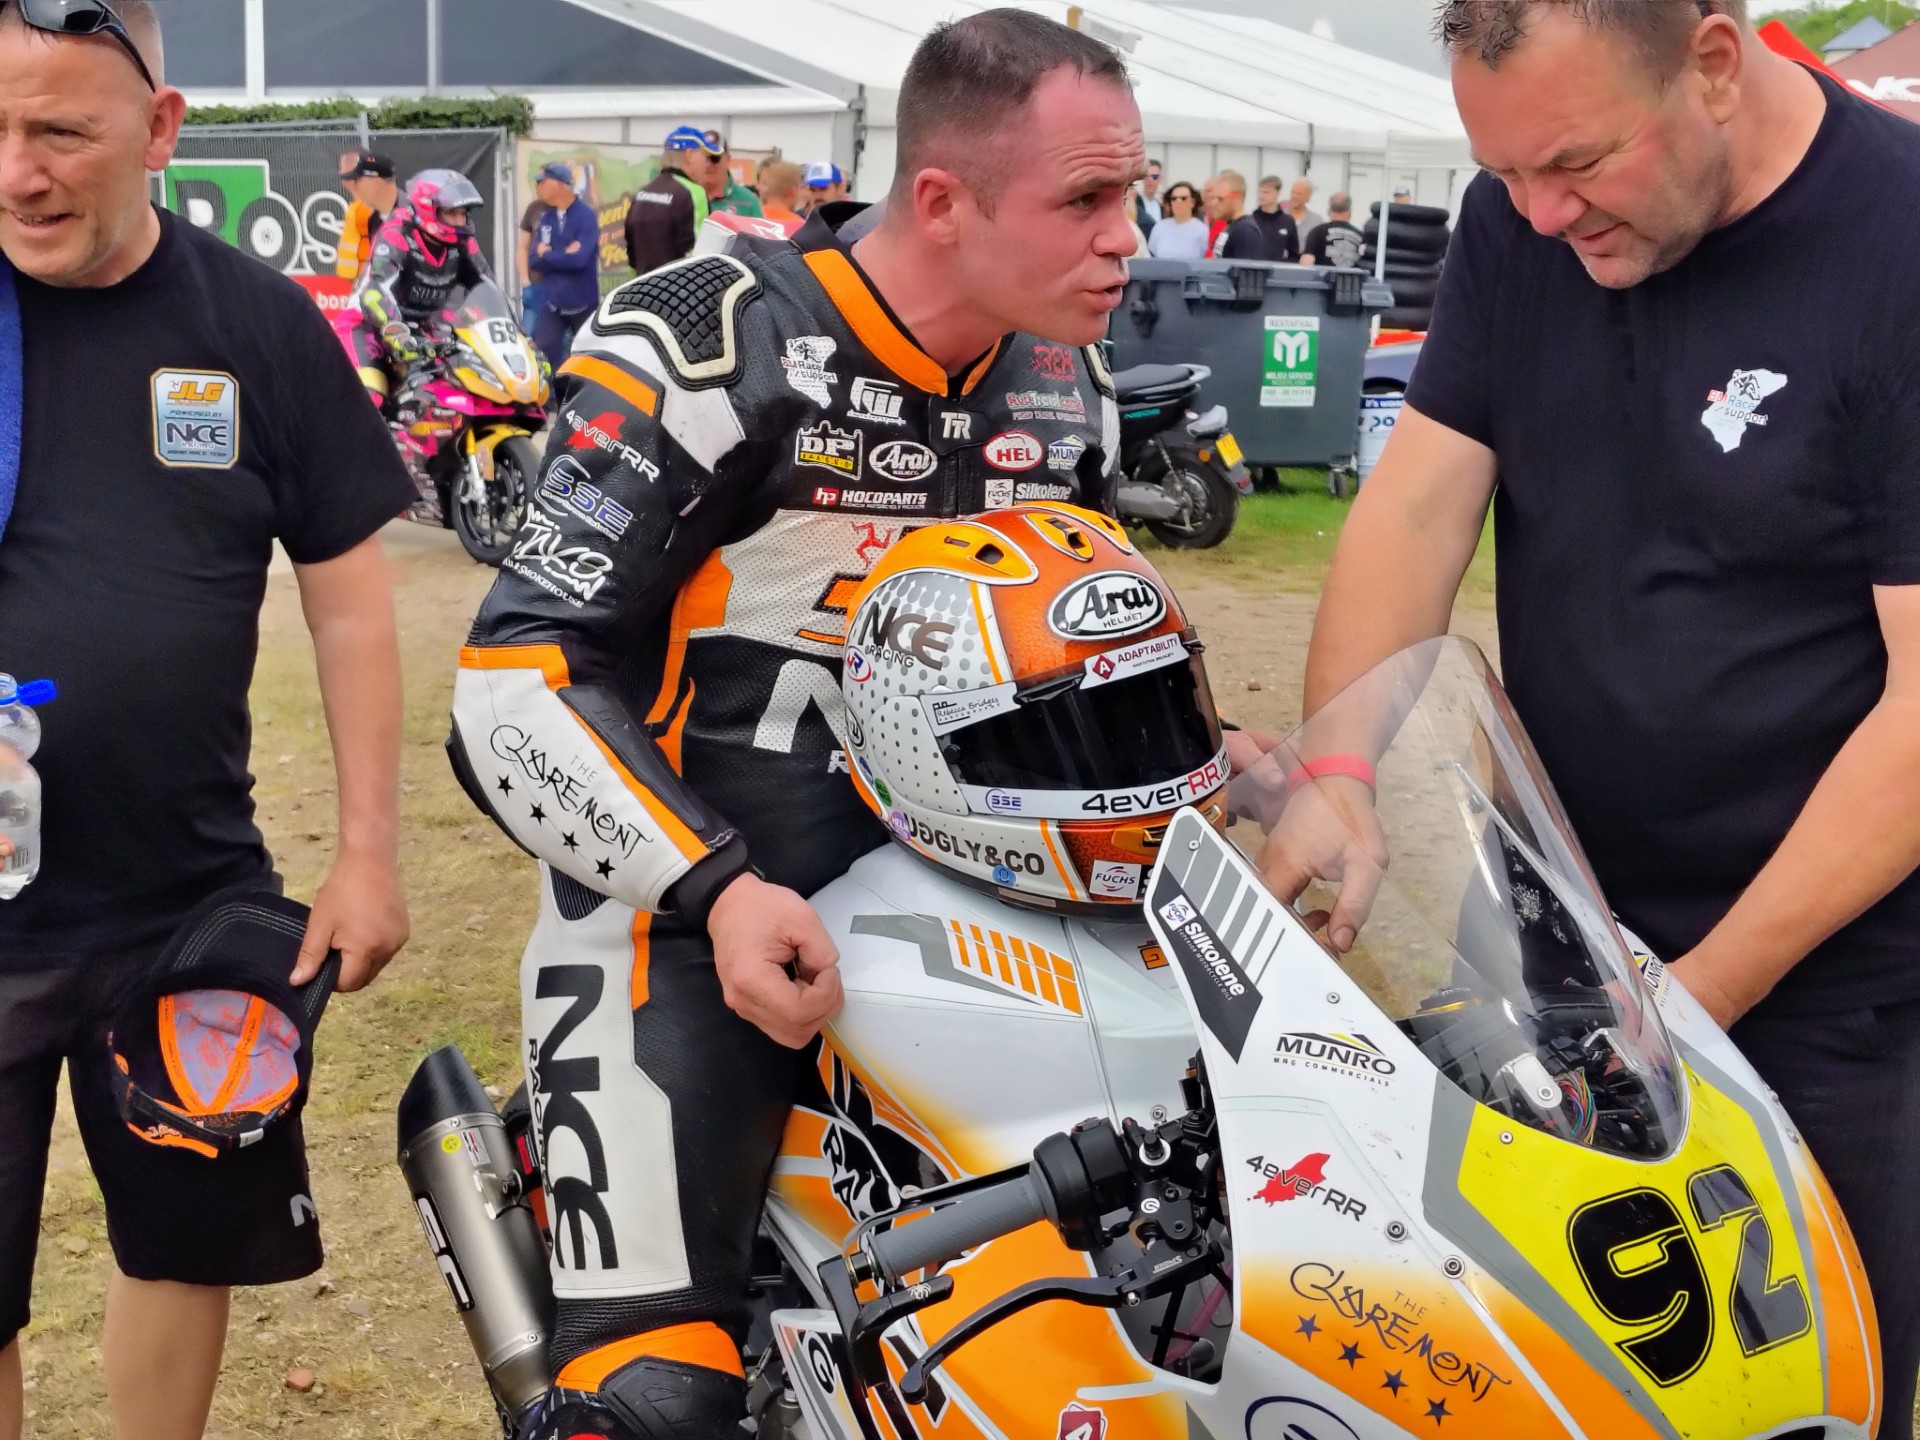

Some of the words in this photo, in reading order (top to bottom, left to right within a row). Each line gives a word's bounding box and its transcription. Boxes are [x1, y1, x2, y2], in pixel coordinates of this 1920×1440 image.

[488, 320, 518, 345] 69
[167, 381, 226, 401] JLG
[1727, 395, 1755, 411] Race
[1724, 407, 1768, 425] support
[165, 421, 228, 447] NCE
[801, 436, 855, 456] DP
[874, 444, 935, 471] Arai
[996, 447, 1035, 462] HEL
[546, 467, 634, 536] SSE
[841, 489, 928, 505] HOCOPARTS
[1015, 482, 1073, 500] Silkolene
[1067, 577, 1154, 631] Arai
[1102, 611, 1144, 629] HELMET
[857, 600, 956, 672] NCE
[868, 644, 915, 668] RACING
[1117, 636, 1179, 664] ADAPTABILITY
[571, 754, 599, 783] THE
[1094, 872, 1137, 885] FUCHS
[1184, 921, 1246, 997] Silkolene
[1276, 1036, 1396, 1076] MUNRO
[1305, 1061, 1390, 1088] COMMERCIALS
[536, 963, 620, 1271] NCE
[1246, 1154, 1367, 1222] 4everRR
[1566, 1162, 1813, 1389] 92
[1394, 1290, 1429, 1319] THE
